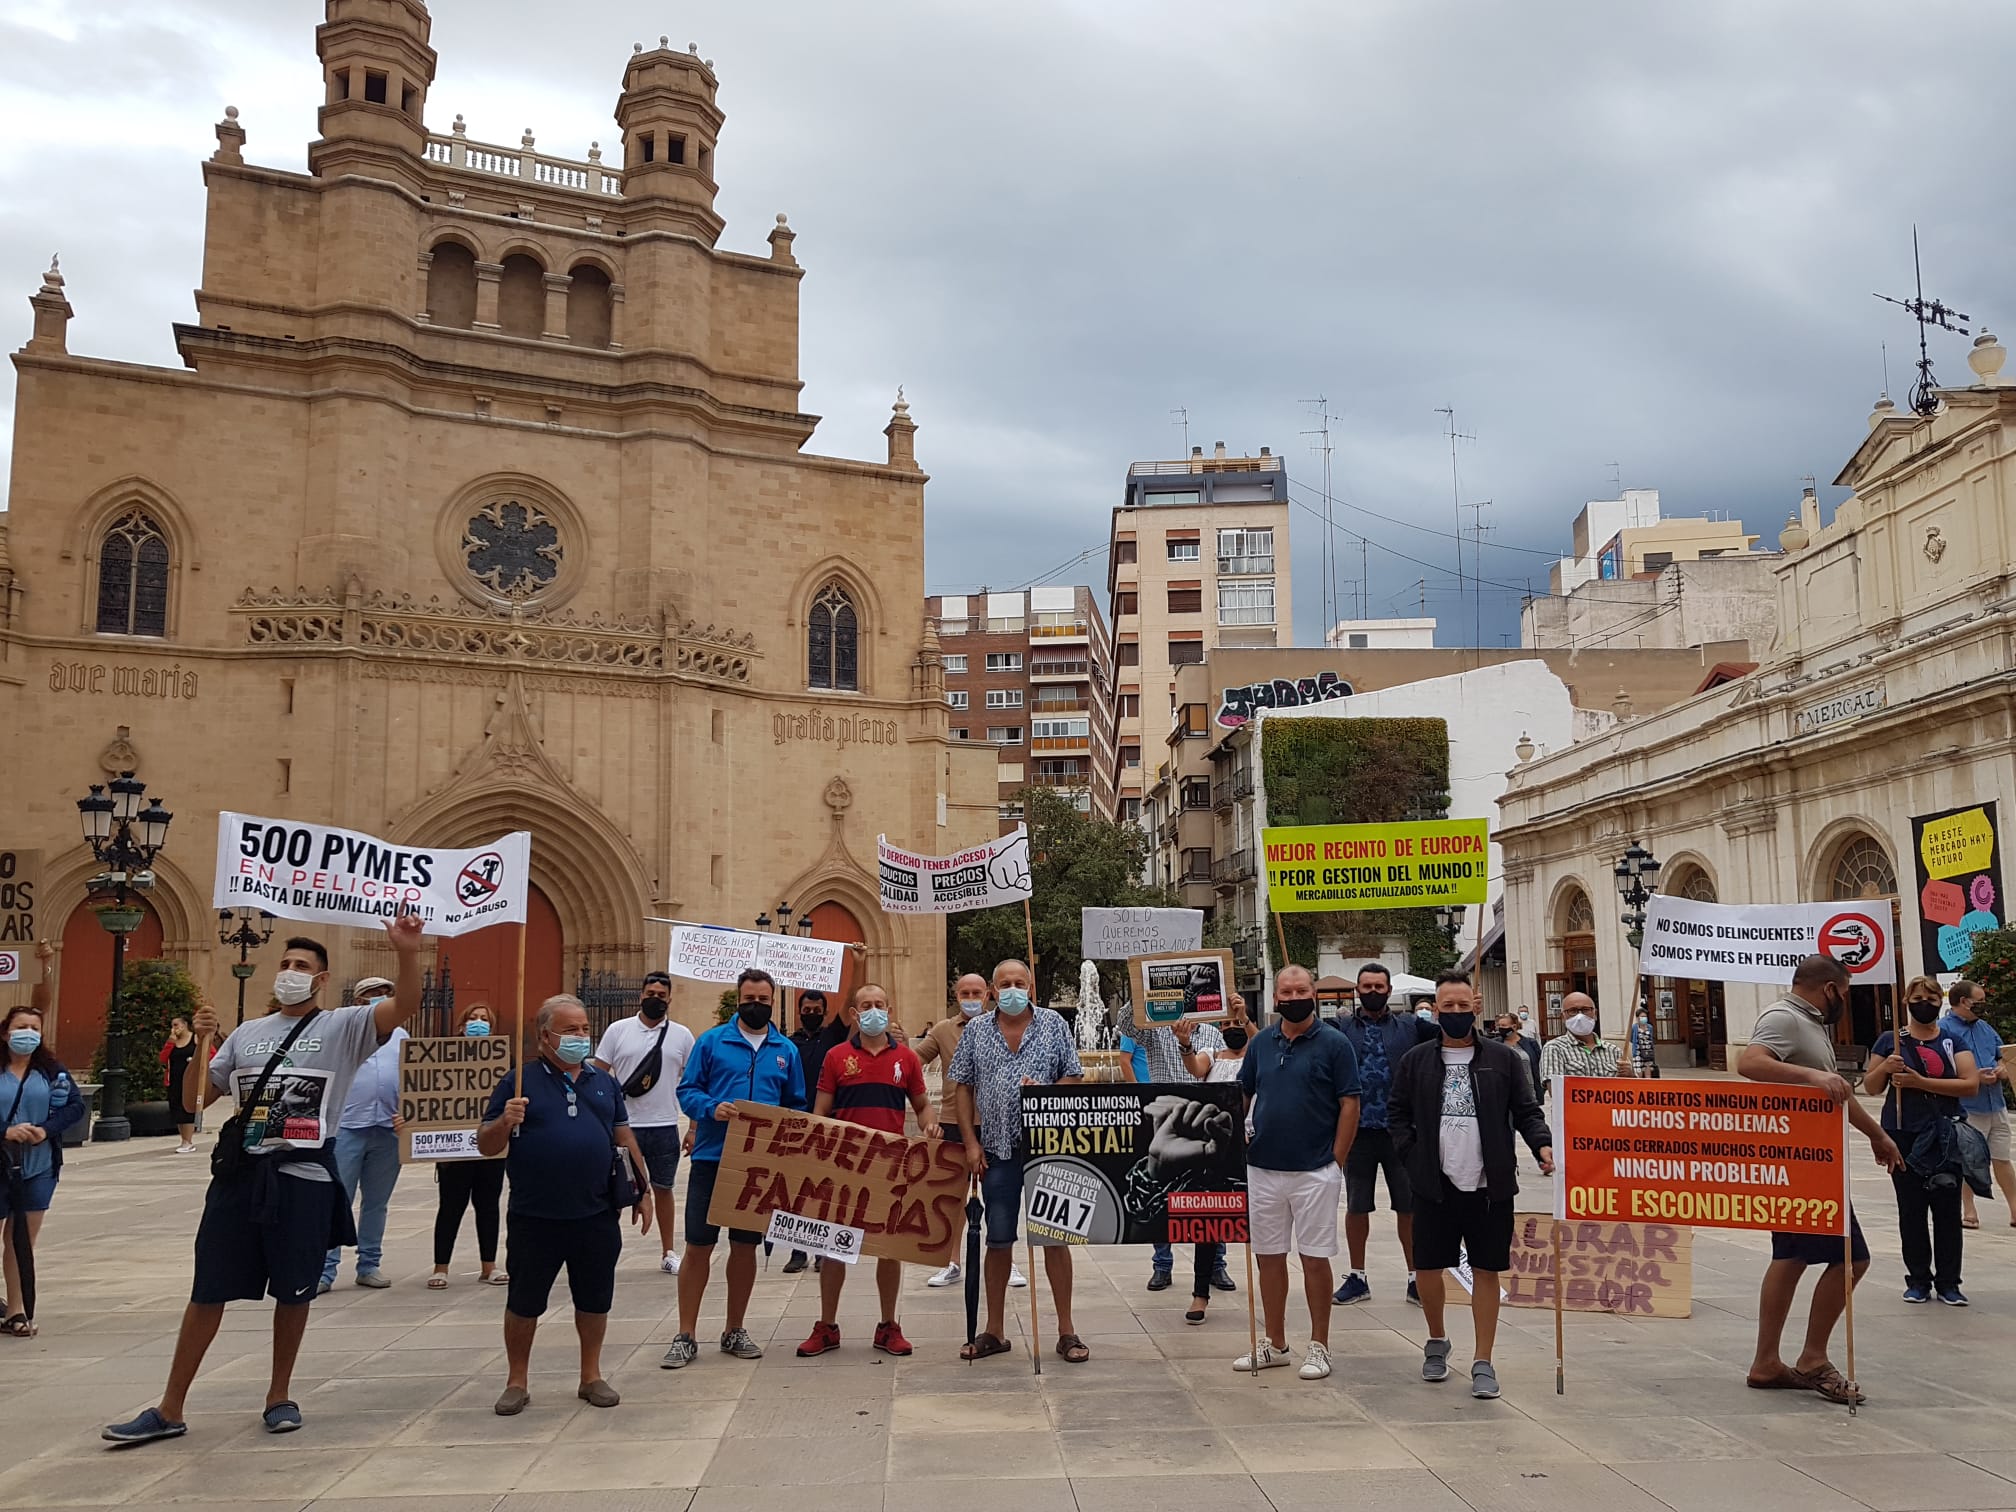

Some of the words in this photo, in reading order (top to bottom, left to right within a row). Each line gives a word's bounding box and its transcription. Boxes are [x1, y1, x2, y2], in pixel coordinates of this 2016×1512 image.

[113, 663, 198, 699] maria
[1807, 690, 1875, 725] MERCAT
[837, 713, 897, 751] plena
[1929, 833, 1939, 844] EN
[1942, 827, 1963, 840] ESTE
[1929, 838, 1967, 856] MERCADO
[1970, 833, 1986, 846] HAY
[239, 822, 313, 866] 500
[319, 834, 433, 888] PYMES
[886, 849, 921, 869] DERECHO
[923, 859, 951, 871] TENER
[953, 849, 987, 868] ACCESO
[988, 846, 997, 858] A:
[1267, 842, 1316, 862] MEJOR
[1324, 839, 1386, 860] RECINTO
[1395, 838, 1414, 857] DE
[1421, 835, 1483, 856] EUROPA
[1931, 852, 1963, 867] FUTURO
[240, 859, 275, 882] EN
[291, 870, 422, 901] PELIGRO
[934, 868, 984, 888] PRECIOS
[1280, 869, 1316, 887] PEOR
[1323, 866, 1381, 885] GESTION
[1388, 864, 1412, 882] DEL
[1419, 862, 1472, 880] MUNDO
[242, 878, 288, 905] BASTA
[292, 889, 312, 908] DE
[934, 886, 988, 902] ACCESIBLES
[1296, 887, 1357, 901] MERCADILLOS
[1359, 885, 1424, 899] ACTUALIZADOS
[1426, 884, 1449, 895] YAAA
[445, 913, 461, 923] NO
[463, 910, 475, 920] AL
[476, 900, 508, 916] ABUSO
[1113, 908, 1150, 923] SOLO
[681, 931, 728, 946] NUESTROS
[1102, 925, 1159, 940] QUEREMOS
[1656, 917, 1671, 932] NO
[1672, 920, 1713, 938] SOMOS
[1717, 926, 1804, 941] DELINCUENTES
[724, 947, 752, 959] TIENEN
[1095, 938, 1166, 955] TRABAJAR
[1651, 944, 1693, 960] SOMOS
[1696, 948, 1735, 964] PYMES
[1738, 952, 1752, 965] EN
[678, 952, 734, 968] DERECHO
[735, 959, 751, 969] DE
[692, 967, 736, 980] COMER
[404, 1039, 507, 1063] EXIGIMOS
[1022, 1097, 1038, 1111] NO
[1040, 1096, 1090, 1111] PEDIMOS
[1091, 1095, 1141, 1110] LIMOSNA
[1571, 1089, 1634, 1105] ESPACIOS
[1637, 1091, 1701, 1107] ABIERTOS
[1705, 1093, 1758, 1110] NINGUN
[1761, 1096, 1834, 1114] CONTAGIO
[1022, 1112, 1076, 1128] TENEMOS
[1079, 1110, 1142, 1126] DERECHOS
[1611, 1109, 1685, 1130] MUCHOS
[1689, 1112, 1790, 1134] PROBLEMAS
[415, 1134, 433, 1145] 500
[435, 1133, 463, 1144] PYMES
[738, 1112, 967, 1187] TENEMOS
[1030, 1126, 1134, 1155] !!BASTA!!
[1573, 1137, 1630, 1152] ESPACIOS
[1634, 1139, 1698, 1155] CERRADOS
[1701, 1142, 1756, 1158] MUCHOS
[1759, 1145, 1833, 1163] CONTAGIOS
[1040, 1163, 1103, 1190] MANIFESTACION
[1613, 1157, 1685, 1181] NINGUN
[1690, 1161, 1790, 1186] PROBLEMA
[1035, 1173, 1044, 1186] A
[1045, 1176, 1080, 1197] PARTIR
[1081, 1186, 1098, 1203] DEL
[1031, 1189, 1070, 1227] DIA
[1075, 1203, 1091, 1231] 7
[1171, 1195, 1243, 1209] MERCADILLOS
[1569, 1186, 1618, 1217] QUE
[1631, 1189, 1839, 1228] ESCONDEIS!????
[773, 1226, 785, 1234] EN
[787, 1231, 825, 1243] PELIGRO
[774, 1213, 794, 1230] 500
[795, 1219, 830, 1238] PYMES
[1050, 1229, 1065, 1242] LOS
[1169, 1218, 1249, 1243] DIGNOS
